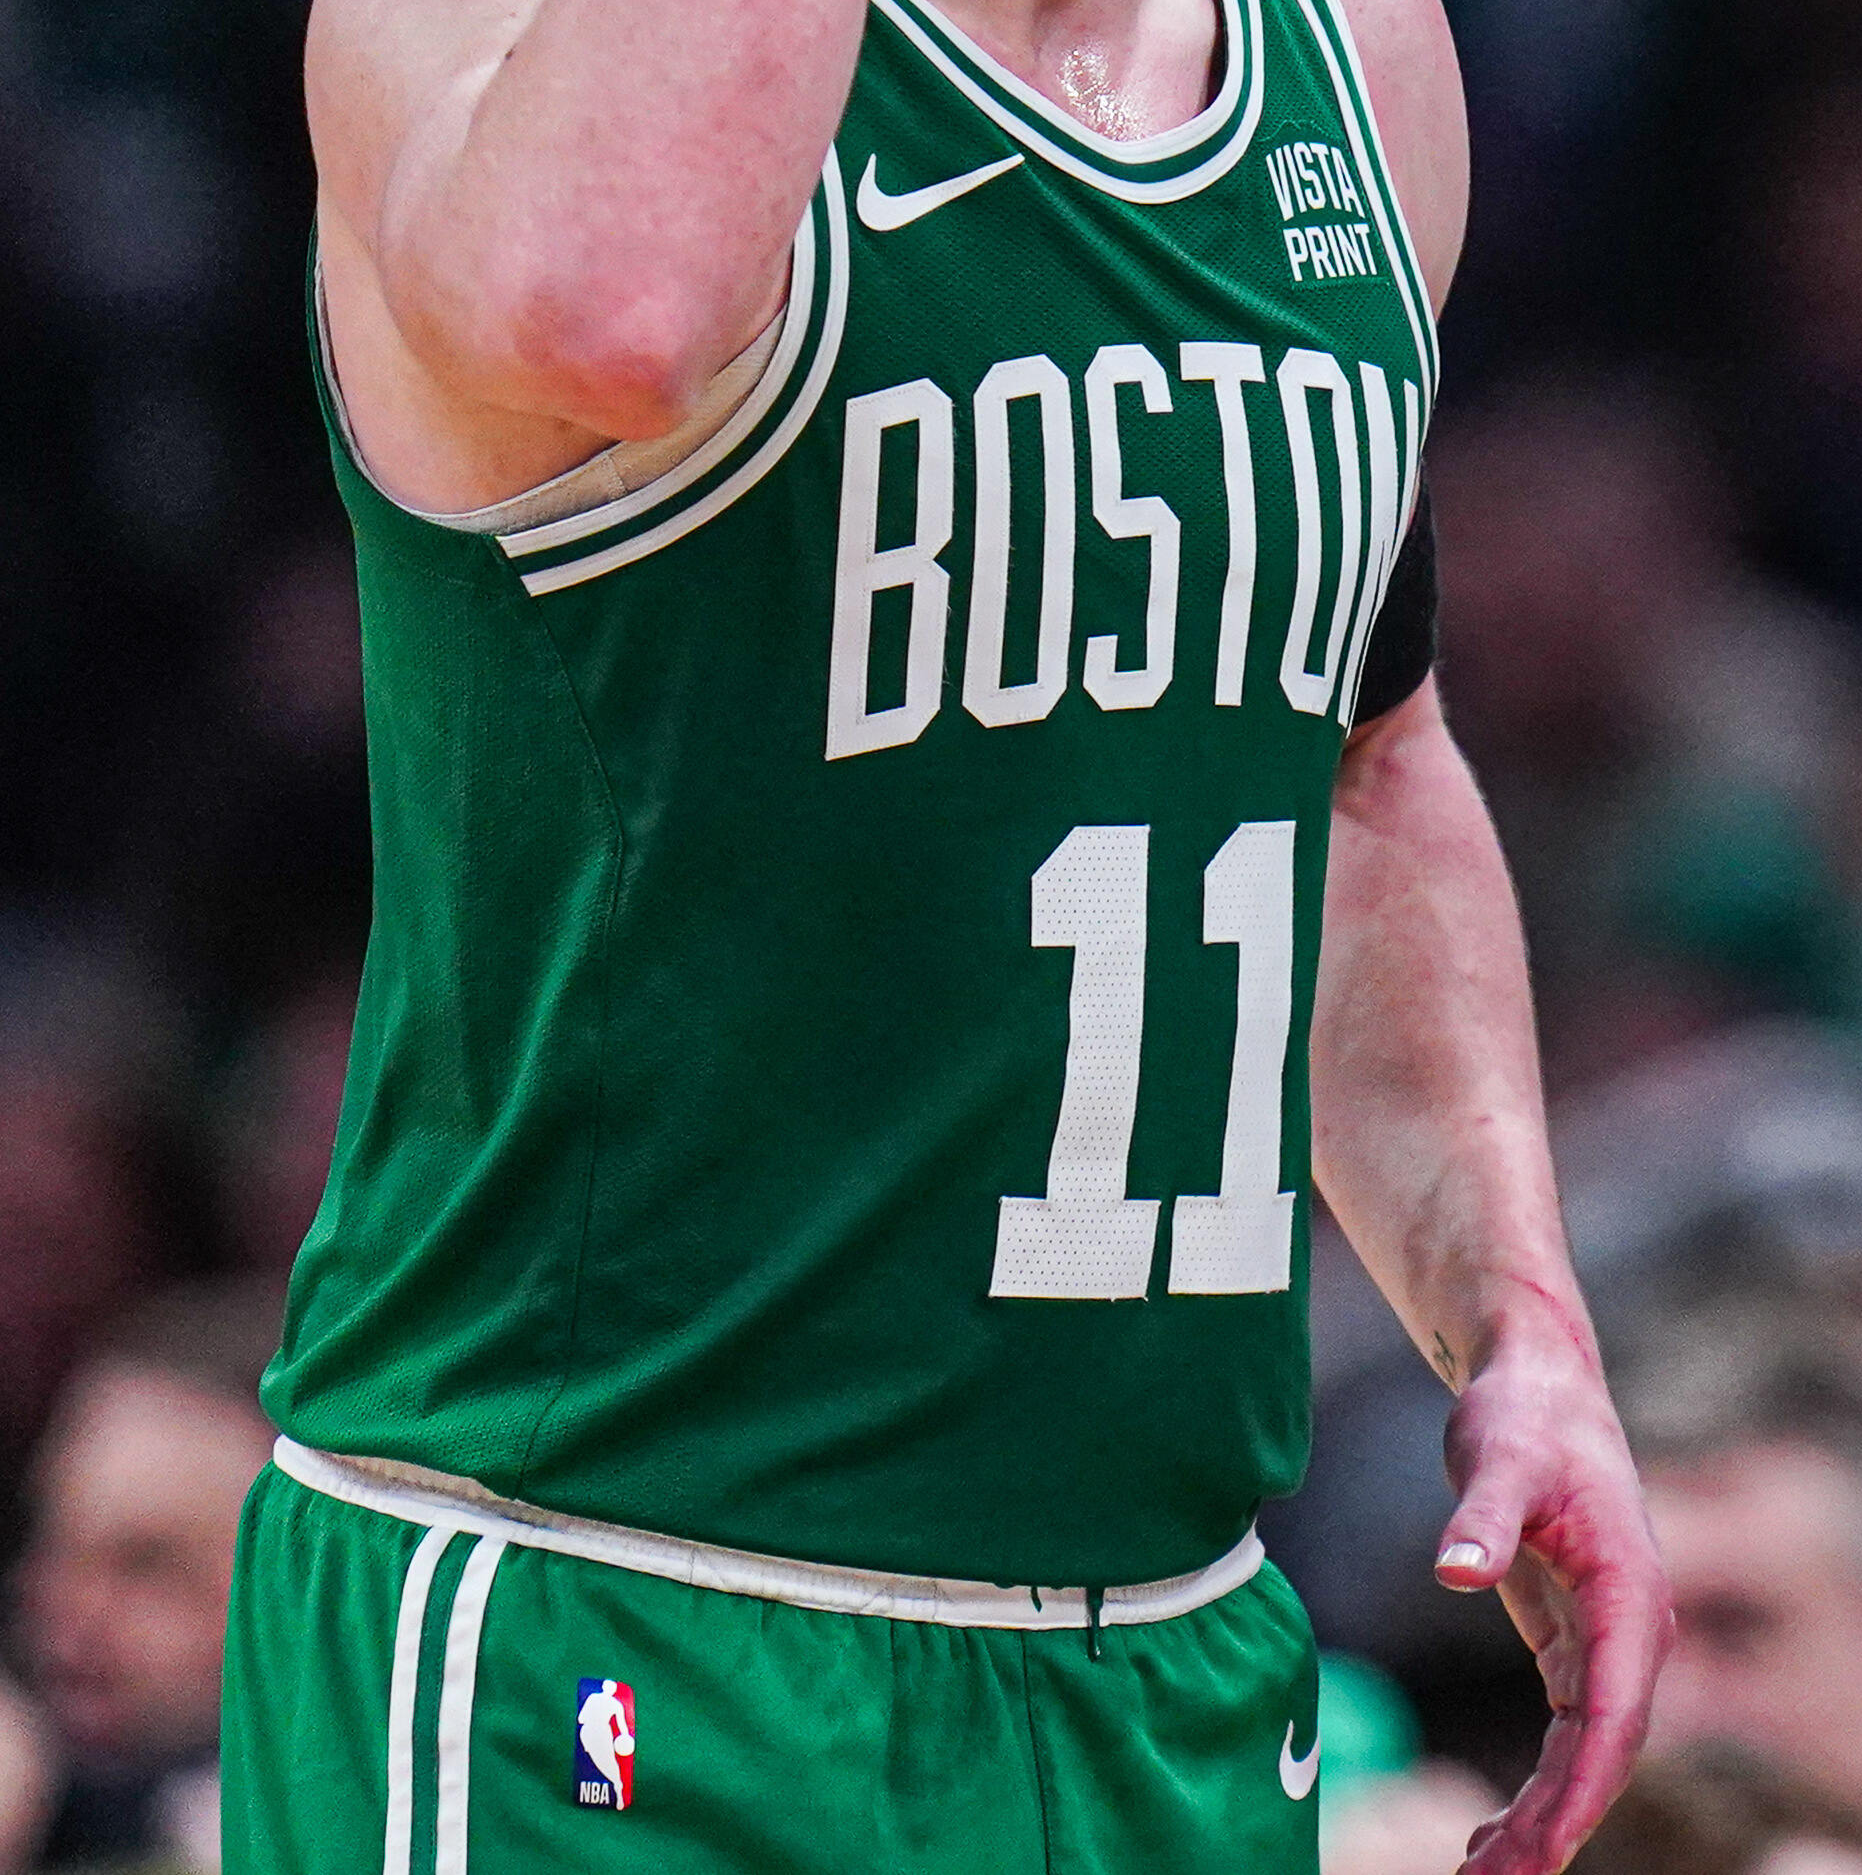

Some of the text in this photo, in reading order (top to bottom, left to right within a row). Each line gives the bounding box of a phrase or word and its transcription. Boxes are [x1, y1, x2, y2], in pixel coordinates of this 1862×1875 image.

[1265, 141, 1366, 222] VISTA
[1282, 223, 1378, 282] PRINT
[825, 341, 1420, 763] BOSTON
[988, 819, 1297, 1302] 11
[579, 1781, 610, 1805] NBA
